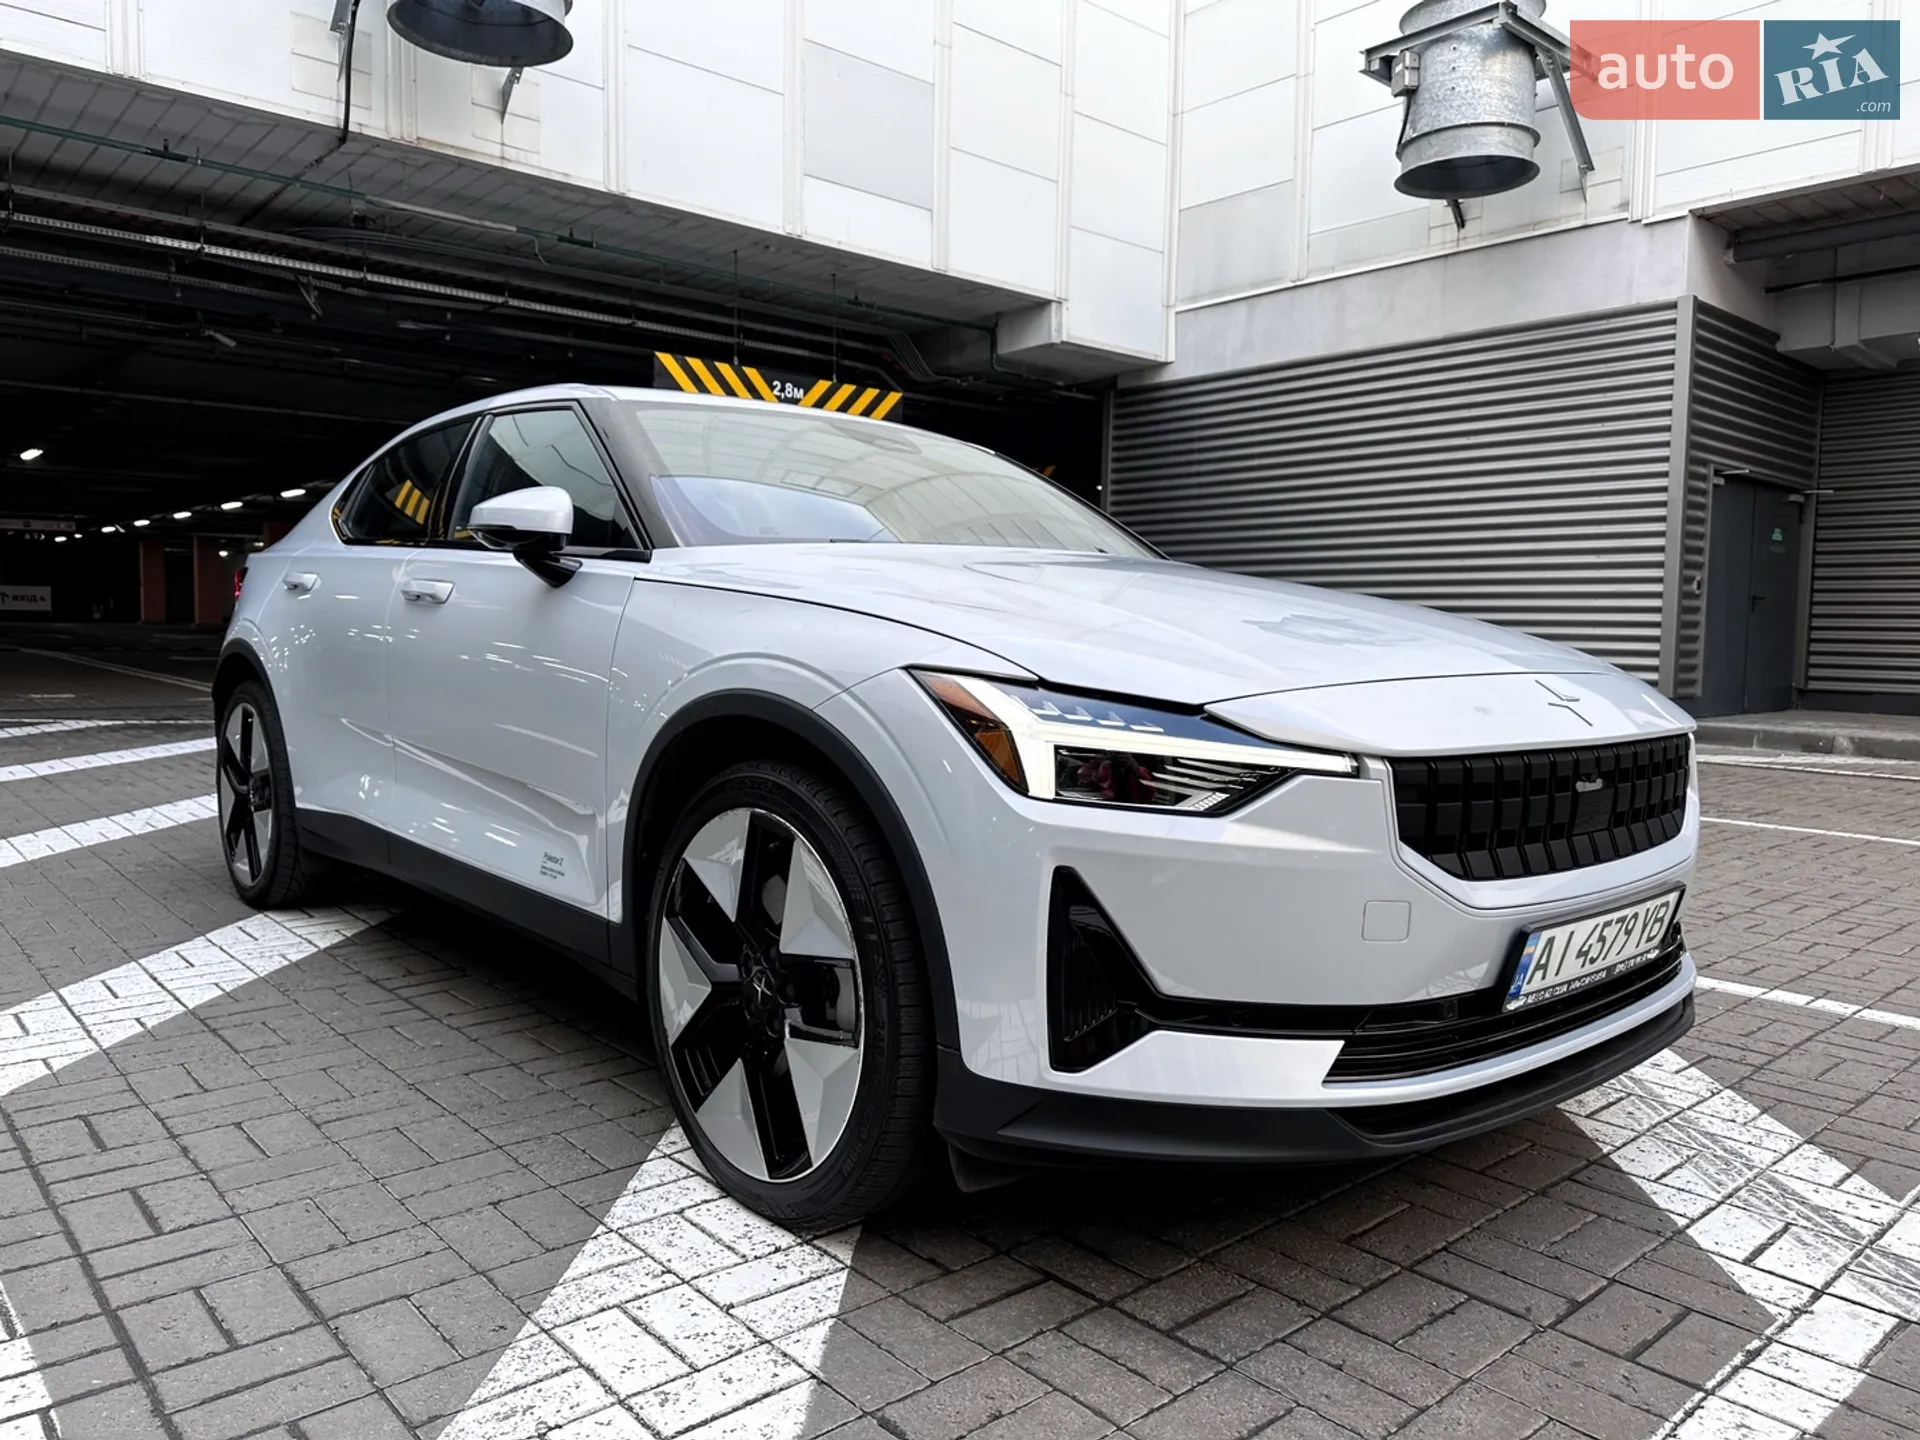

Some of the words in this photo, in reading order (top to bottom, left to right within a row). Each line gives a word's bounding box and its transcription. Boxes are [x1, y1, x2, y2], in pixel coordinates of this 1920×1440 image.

[1526, 930, 1574, 985] AI
[1575, 912, 1638, 969] 4579
[1635, 900, 1671, 949] YB
